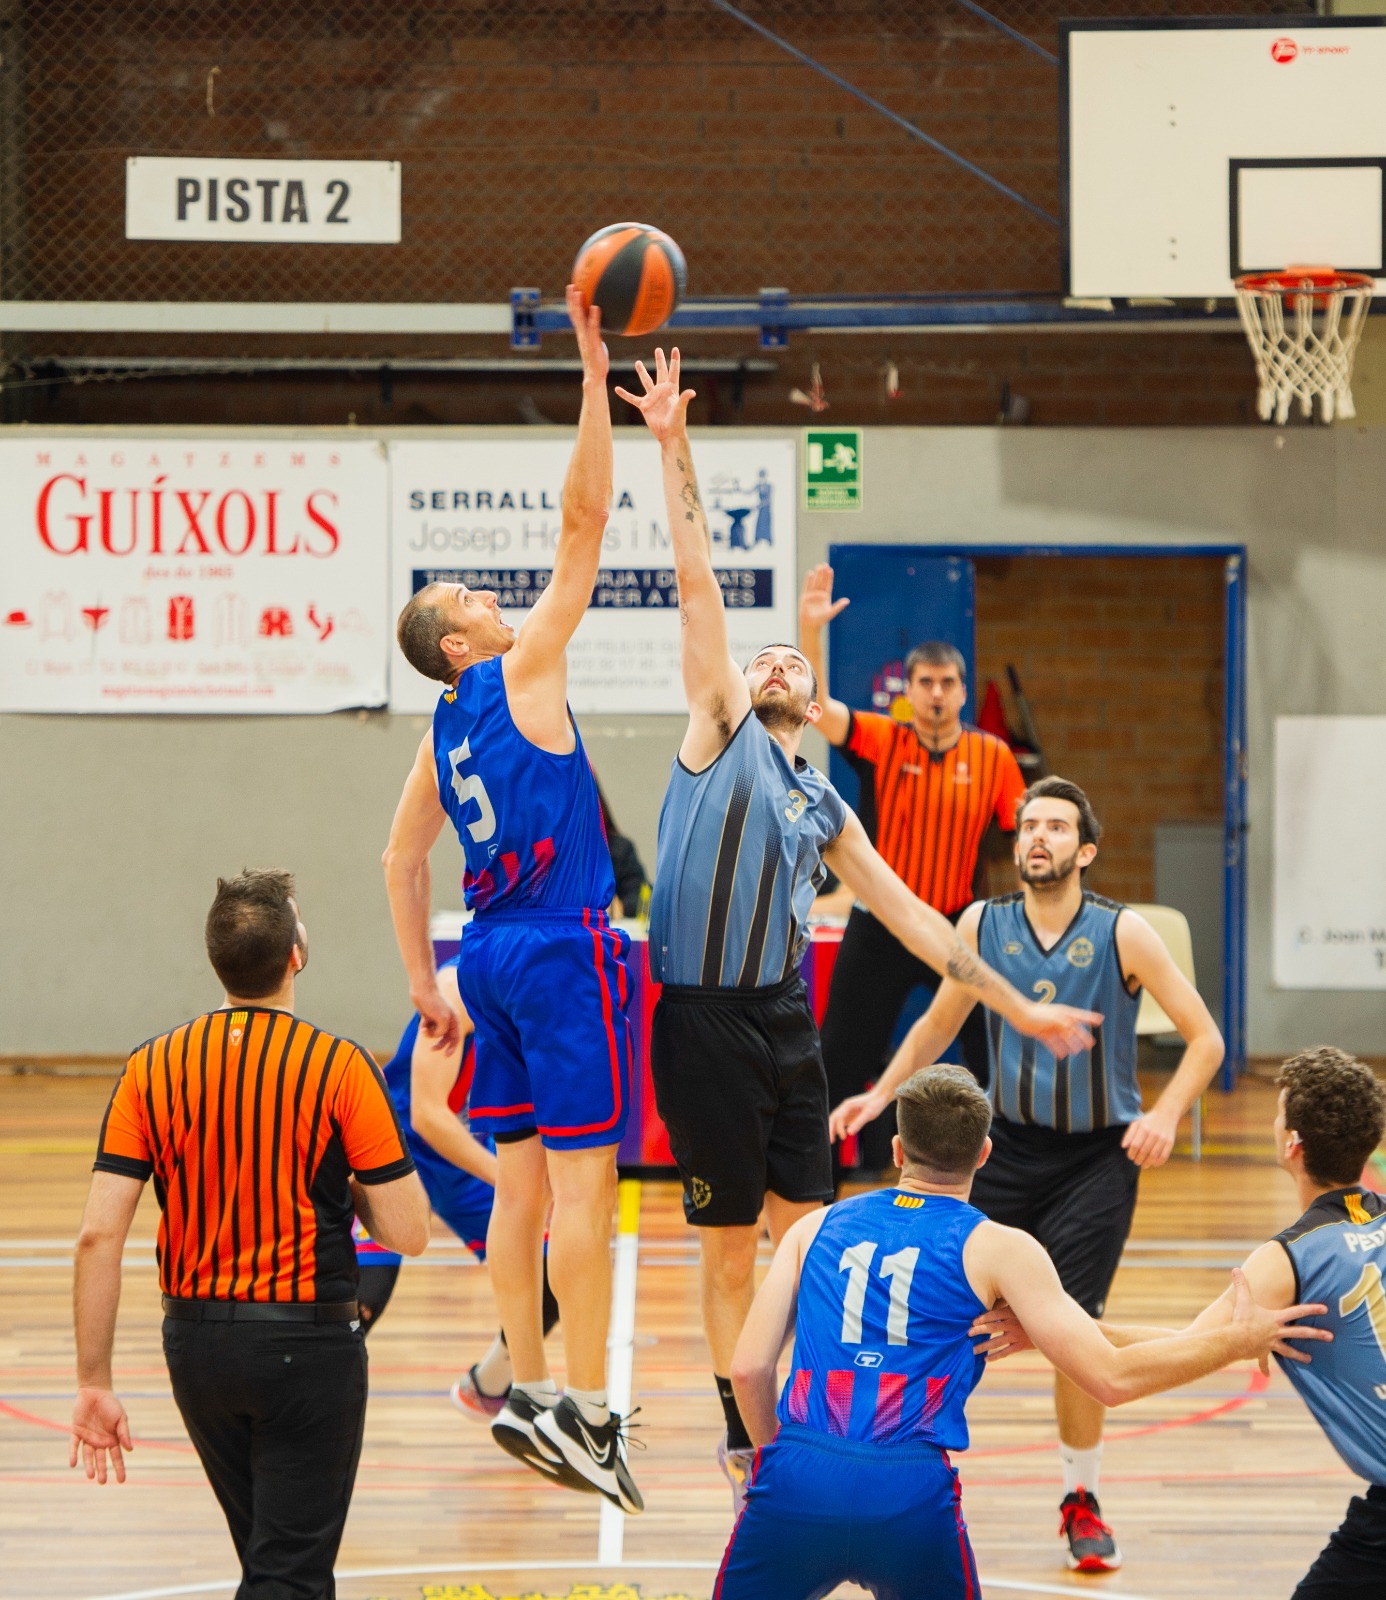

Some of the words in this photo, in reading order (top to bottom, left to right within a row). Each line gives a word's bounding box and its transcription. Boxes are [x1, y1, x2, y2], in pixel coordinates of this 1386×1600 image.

[176, 177, 308, 223] PISTA
[325, 180, 350, 223] 2
[36, 473, 341, 558] GUÍXOLS
[409, 521, 512, 557] Josep
[631, 521, 638, 549] i
[598, 589, 642, 607] PER
[647, 589, 663, 606] A
[448, 736, 497, 843] 5
[785, 789, 808, 822] 3
[1033, 979, 1057, 1005] 2
[839, 1241, 920, 1346] 11
